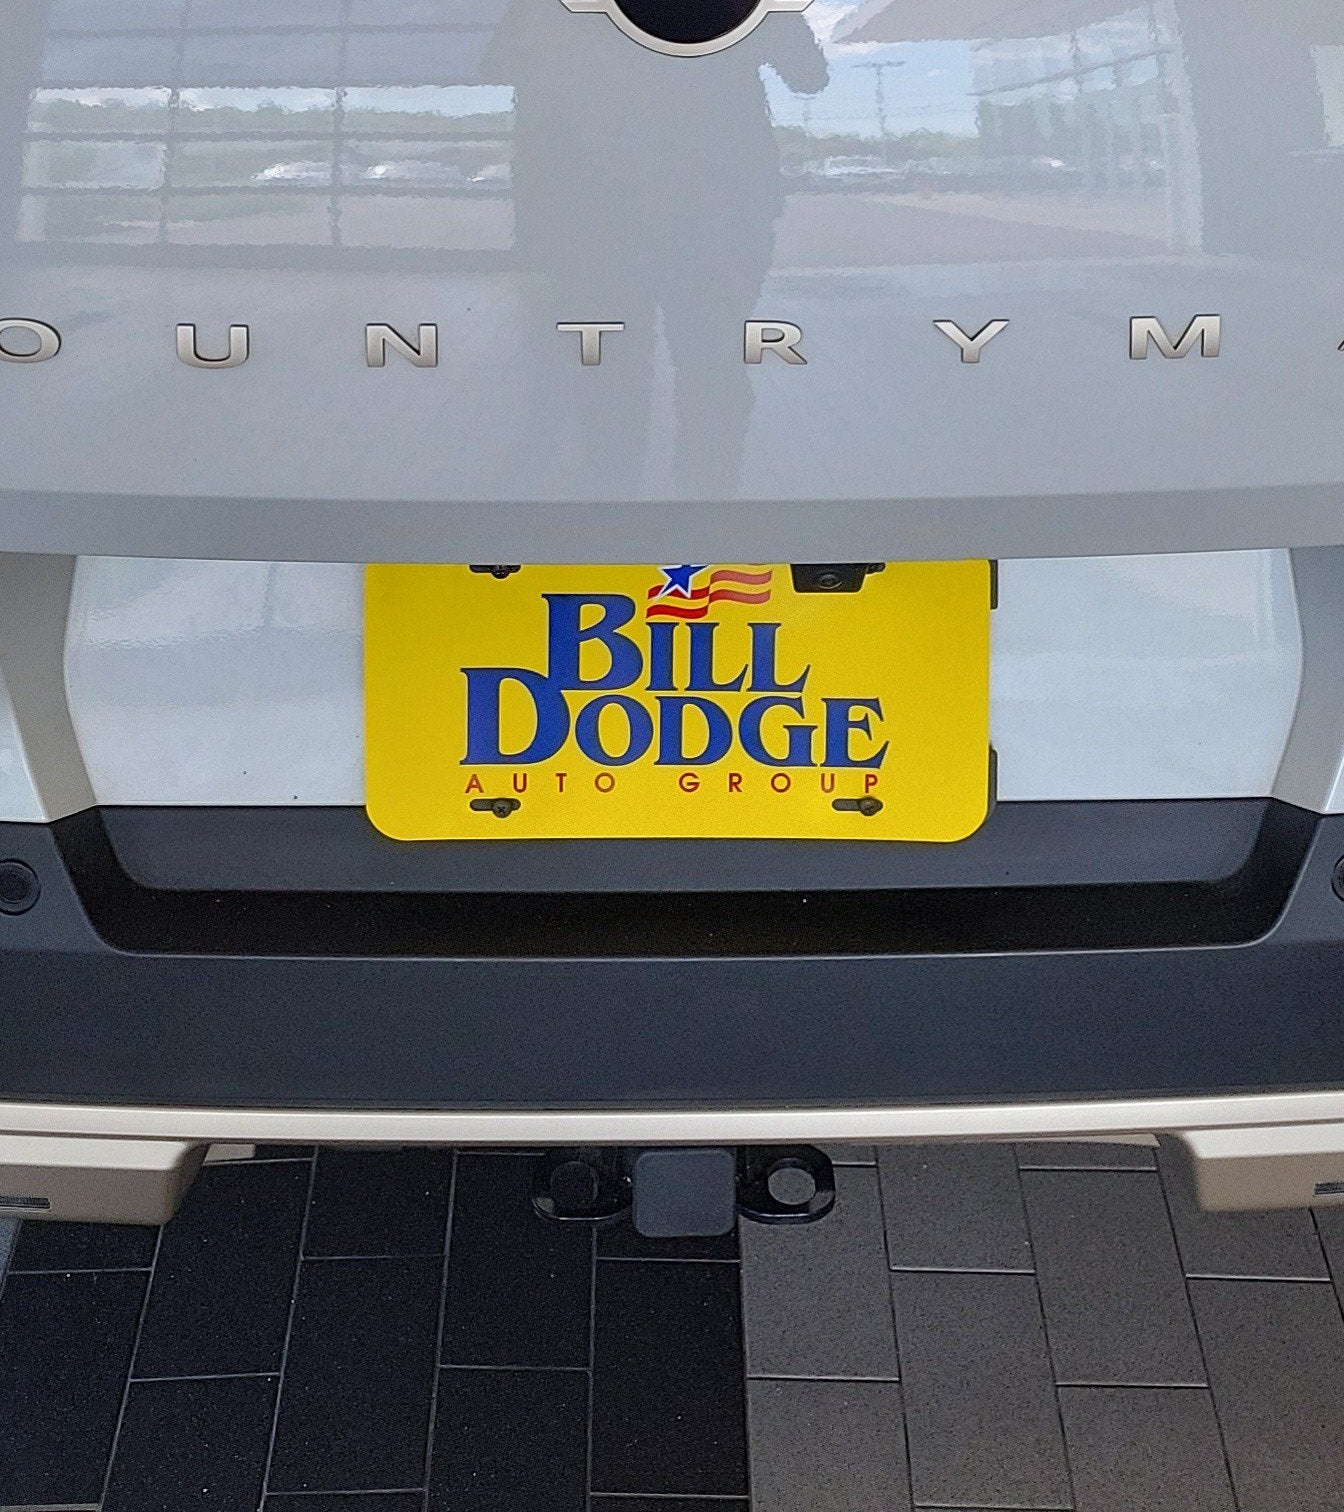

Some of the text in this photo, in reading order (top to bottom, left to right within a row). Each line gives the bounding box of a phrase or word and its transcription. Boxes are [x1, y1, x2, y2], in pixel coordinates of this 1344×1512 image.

[542, 593, 811, 693] BILL
[459, 667, 890, 769] DODGE
[465, 772, 880, 795] AUTO GROUP
